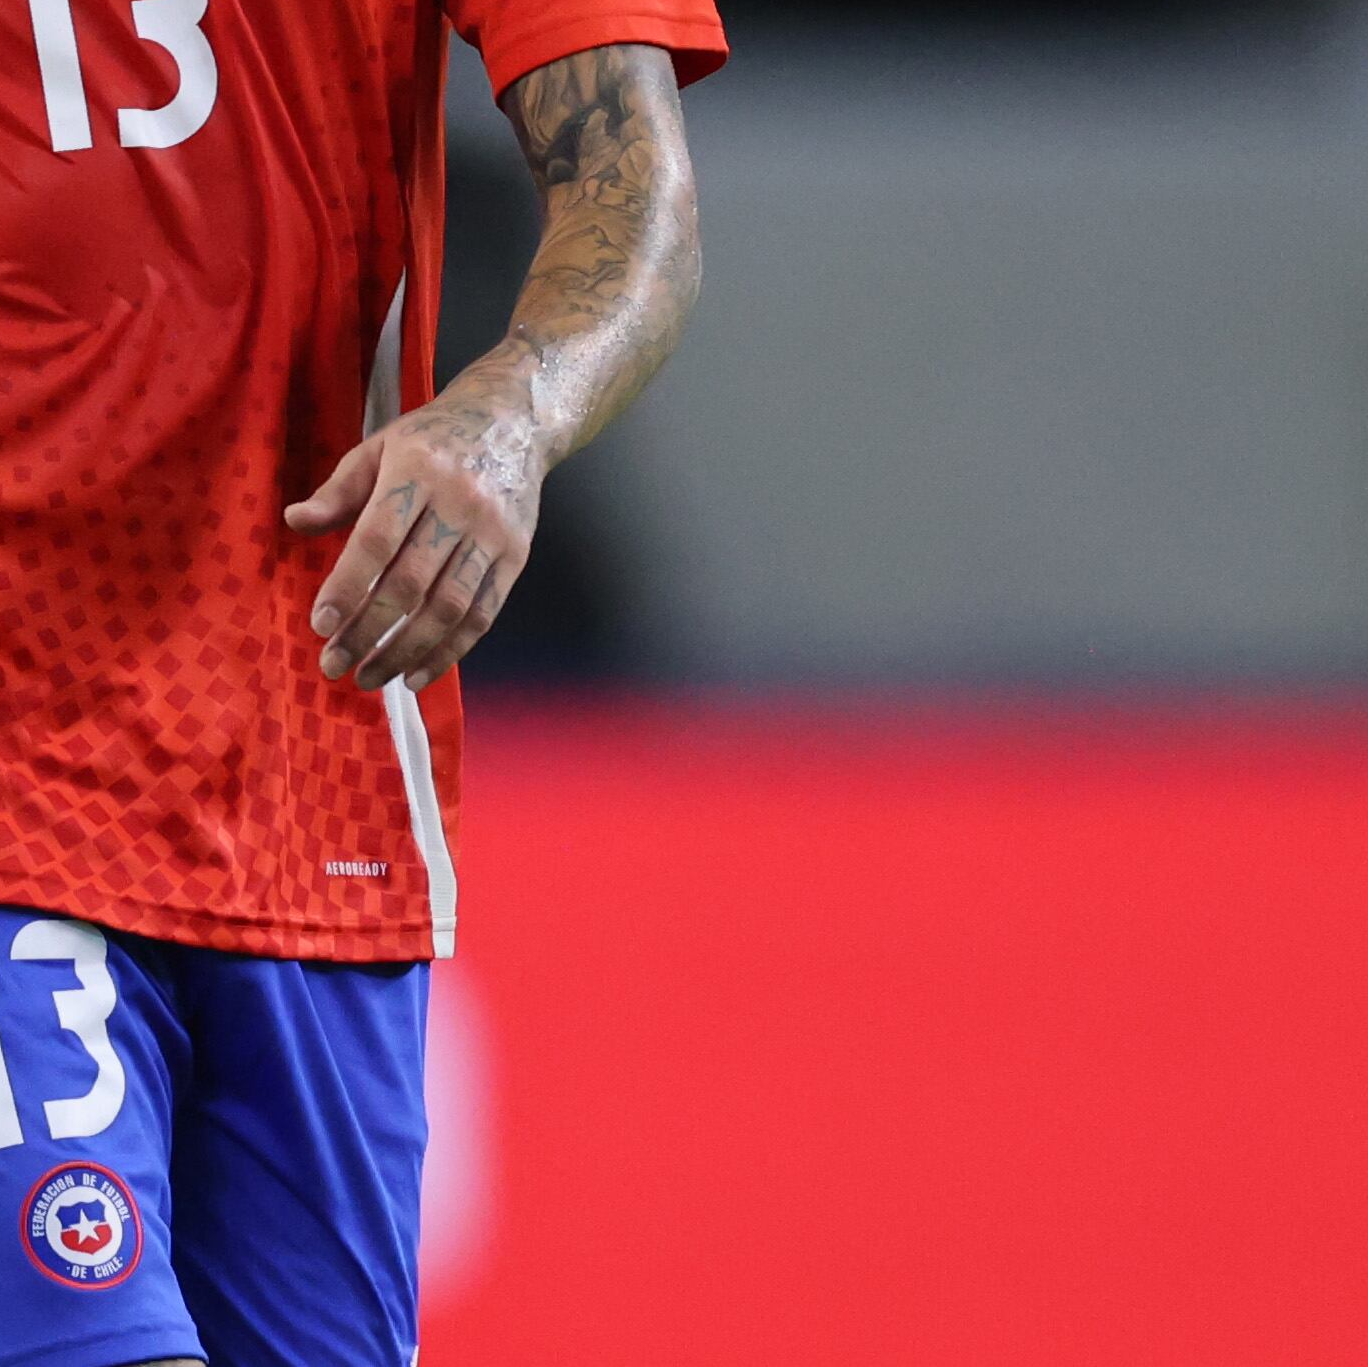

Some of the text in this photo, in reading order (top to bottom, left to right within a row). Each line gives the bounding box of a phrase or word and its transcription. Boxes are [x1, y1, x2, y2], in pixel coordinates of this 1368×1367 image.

[325, 861, 387, 877] AEROREADY
[32, 1173, 130, 1237] FEDERACION DE FUTBOL
[71, 1256, 123, 1279] DE CHILE
